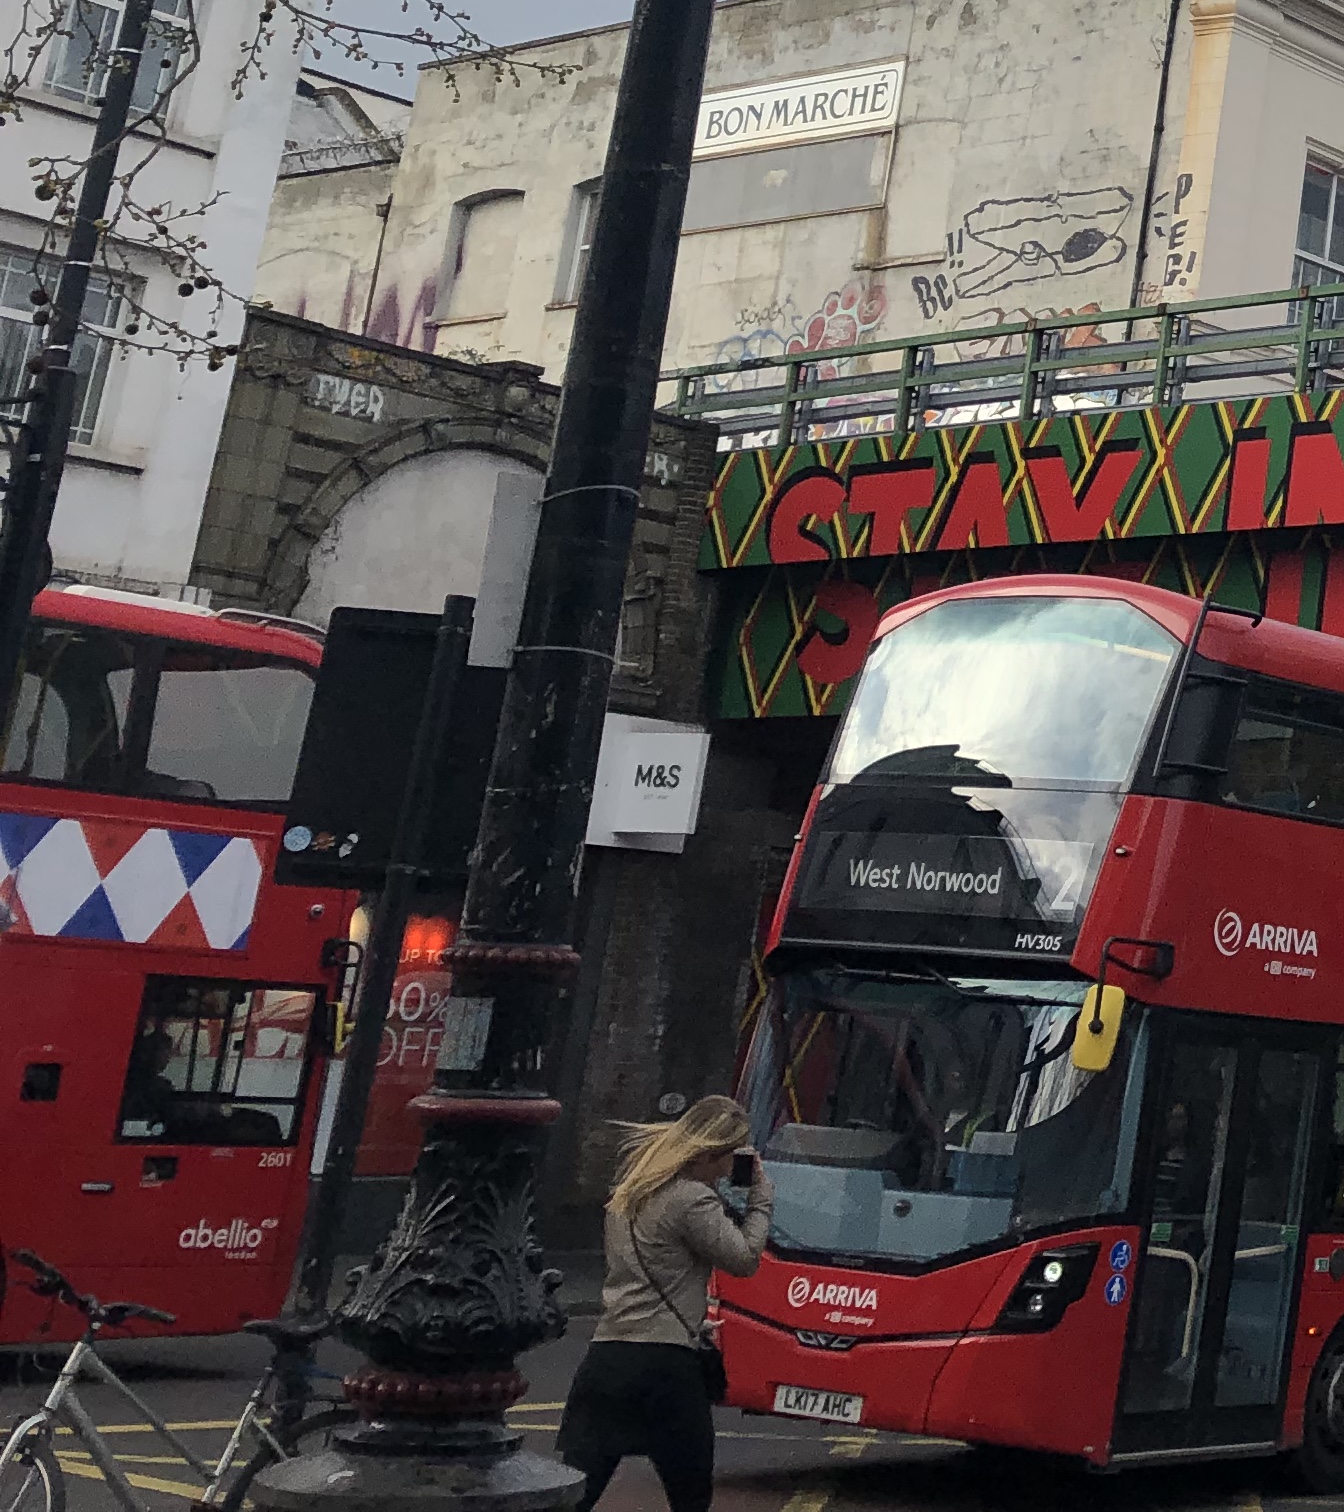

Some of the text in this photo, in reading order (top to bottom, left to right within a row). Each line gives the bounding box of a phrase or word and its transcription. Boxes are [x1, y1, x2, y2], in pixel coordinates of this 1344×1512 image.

[705, 74, 889, 140] BON MARCHÉ
[634, 764, 682, 788] M&S
[850, 857, 1079, 911] West Norwood 2
[1014, 933, 1063, 952] HV305
[1245, 922, 1318, 958] ARRIVA
[1283, 964, 1317, 979] company
[386, 981, 450, 1022] 0%
[258, 1152, 293, 1168] 2601
[179, 1218, 263, 1249] abellio
[809, 1282, 878, 1311] ARRIVA
[783, 1388, 853, 1418] LX17 AHC
